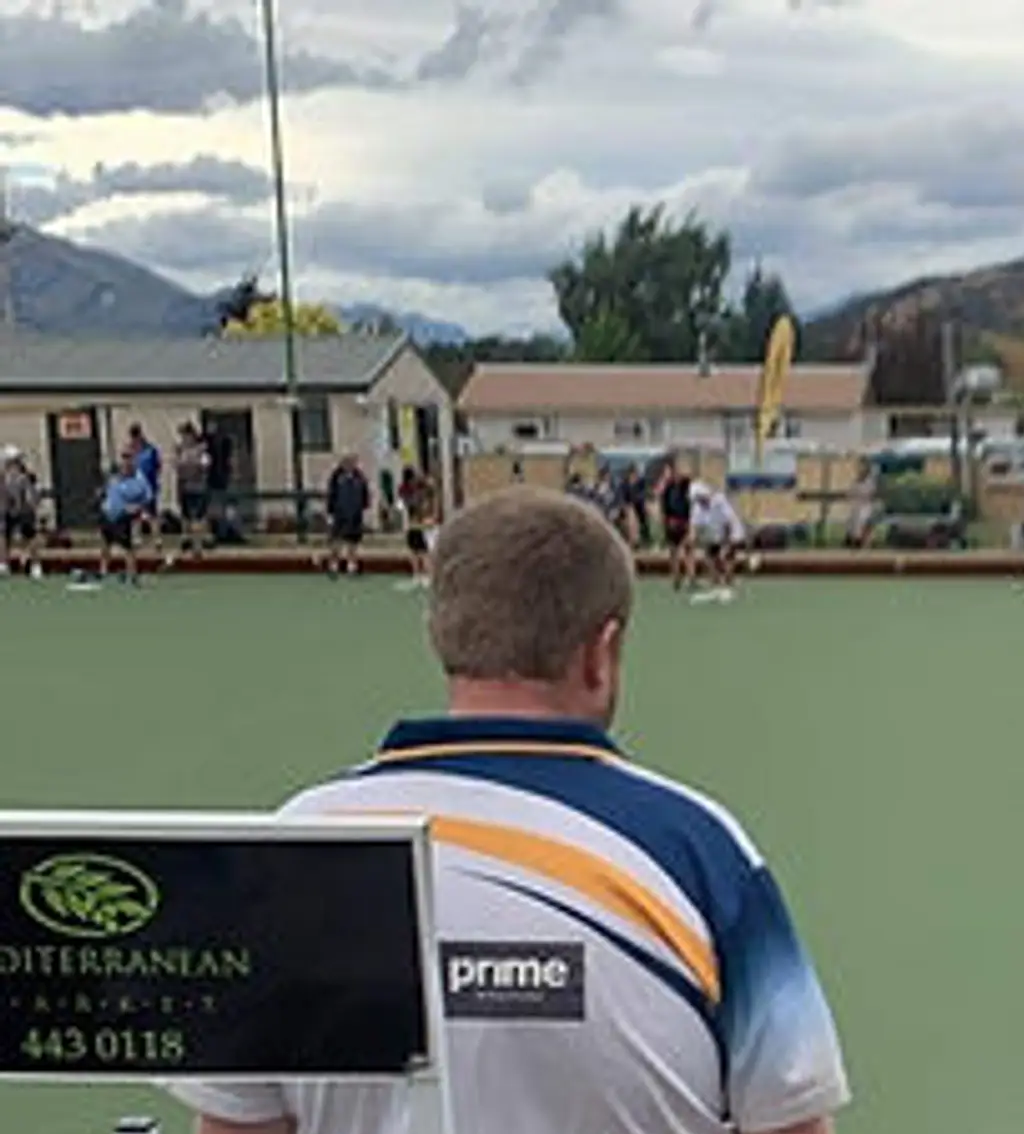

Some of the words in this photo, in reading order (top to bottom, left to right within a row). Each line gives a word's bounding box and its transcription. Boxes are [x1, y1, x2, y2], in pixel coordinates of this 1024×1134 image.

[449, 956, 569, 992] prime
[20, 1027, 87, 1059] 443
[94, 1027, 185, 1061] 0118
